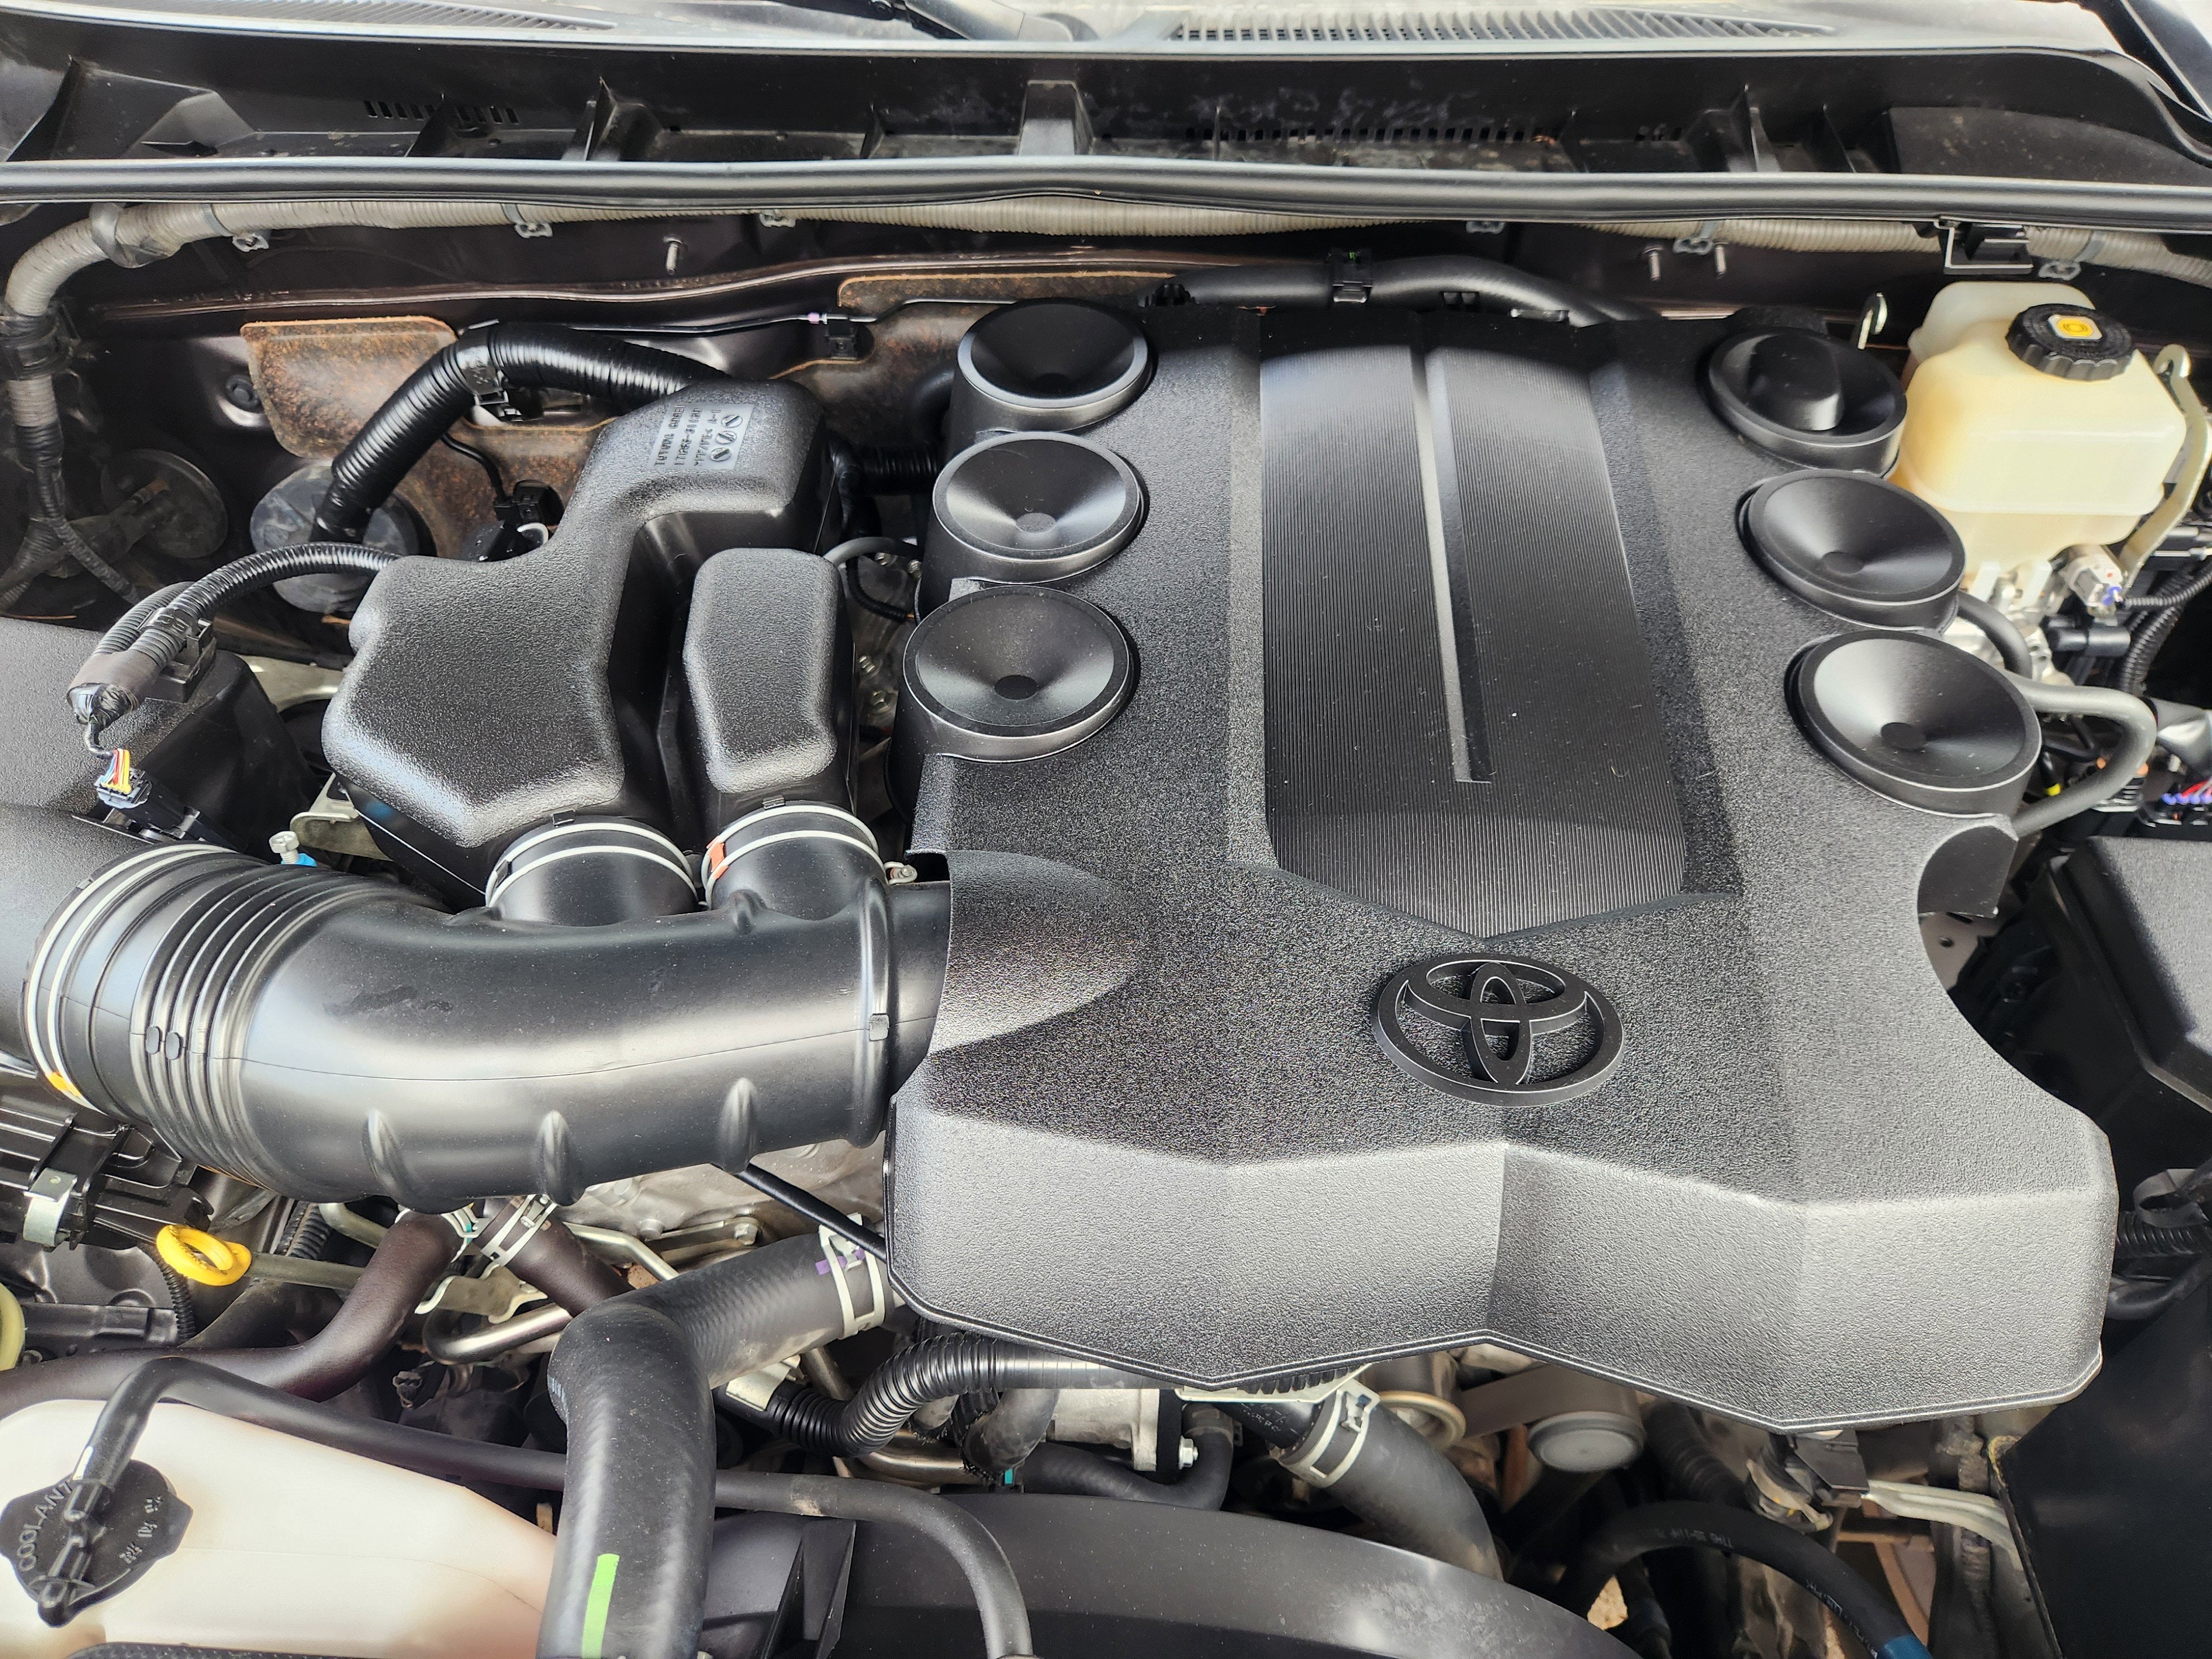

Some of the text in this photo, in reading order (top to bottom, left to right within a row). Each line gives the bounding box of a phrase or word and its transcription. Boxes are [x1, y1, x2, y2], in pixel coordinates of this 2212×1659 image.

[654, 405, 685, 466] TOYOTA GOSEI
[16, 1481, 72, 1572] COOLANT
